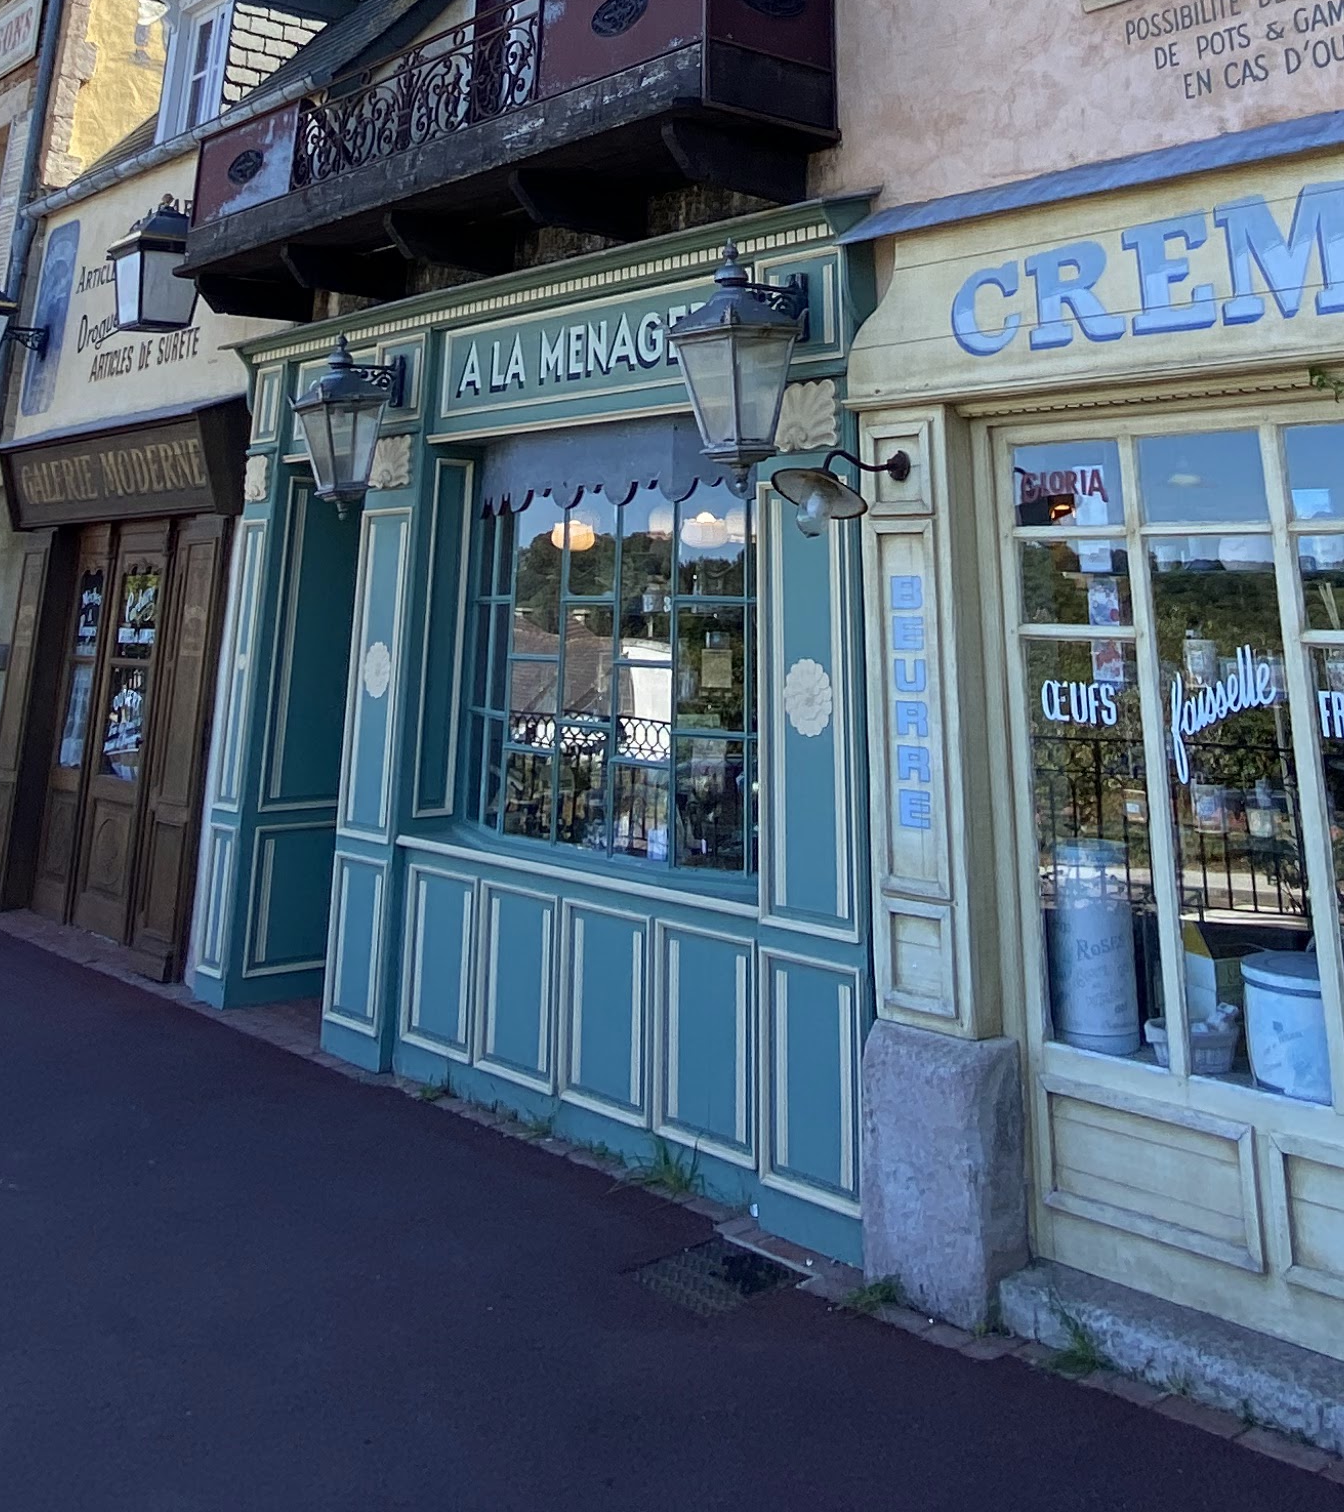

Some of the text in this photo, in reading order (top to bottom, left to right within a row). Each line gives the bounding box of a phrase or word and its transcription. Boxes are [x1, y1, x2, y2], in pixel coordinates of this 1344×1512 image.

[1155, 42, 1180, 70] DE
[1197, 24, 1252, 60] POTS
[1266, 21, 1285, 42] &
[1183, 68, 1213, 100] EN
[1224, 54, 1269, 89] CAS
[88, 346, 134, 383] ARTICLES
[138, 339, 154, 372] DE
[457, 301, 707, 398] A LA MENAGE
[20, 455, 98, 505] GALERIE
[99, 438, 206, 497] MODERNE
[1020, 469, 1109, 503] GLORIA
[890, 575, 931, 829] BEURRE
[1042, 678, 1118, 727] ŒUFS
[1169, 645, 1277, 785] faisselle
